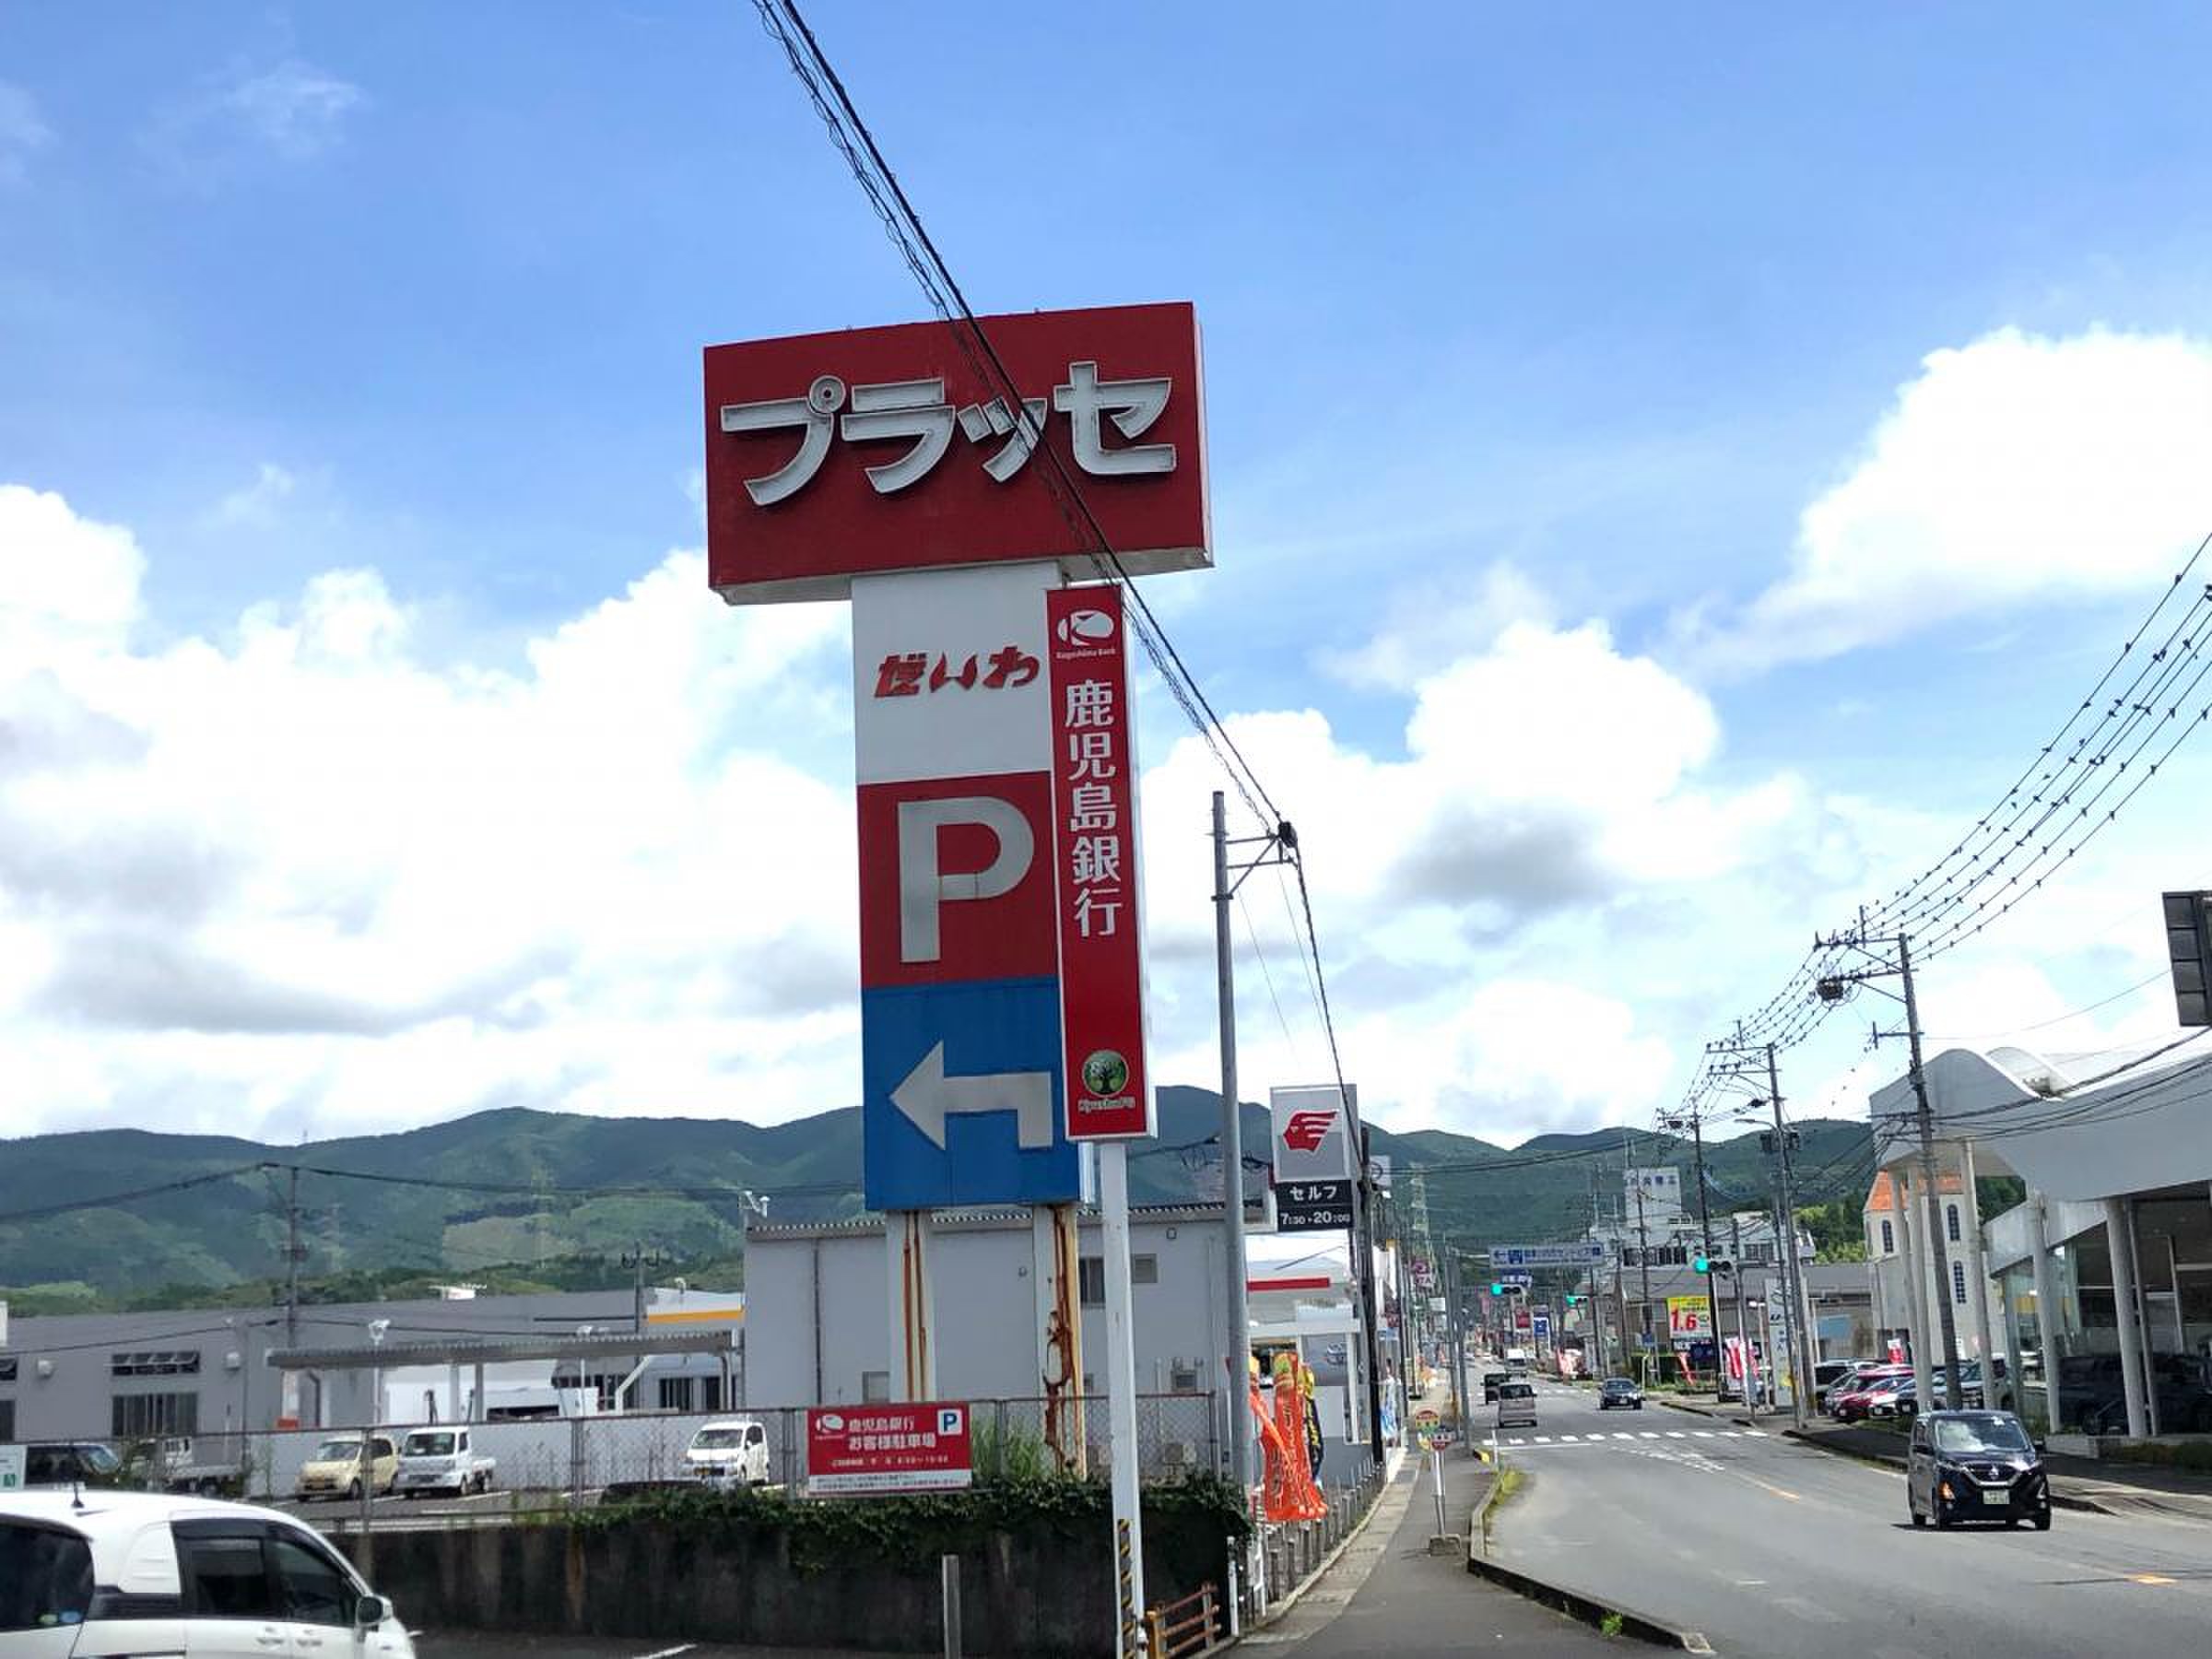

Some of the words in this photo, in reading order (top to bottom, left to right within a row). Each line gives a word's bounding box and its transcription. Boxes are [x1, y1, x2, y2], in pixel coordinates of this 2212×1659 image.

[721, 360, 1177, 506] プラッセ
[898, 795, 1035, 964] P
[1065, 678, 1123, 938] 鹿児島銀行
[1289, 1185, 1337, 1201] セルフ
[943, 1412, 958, 1431] P
